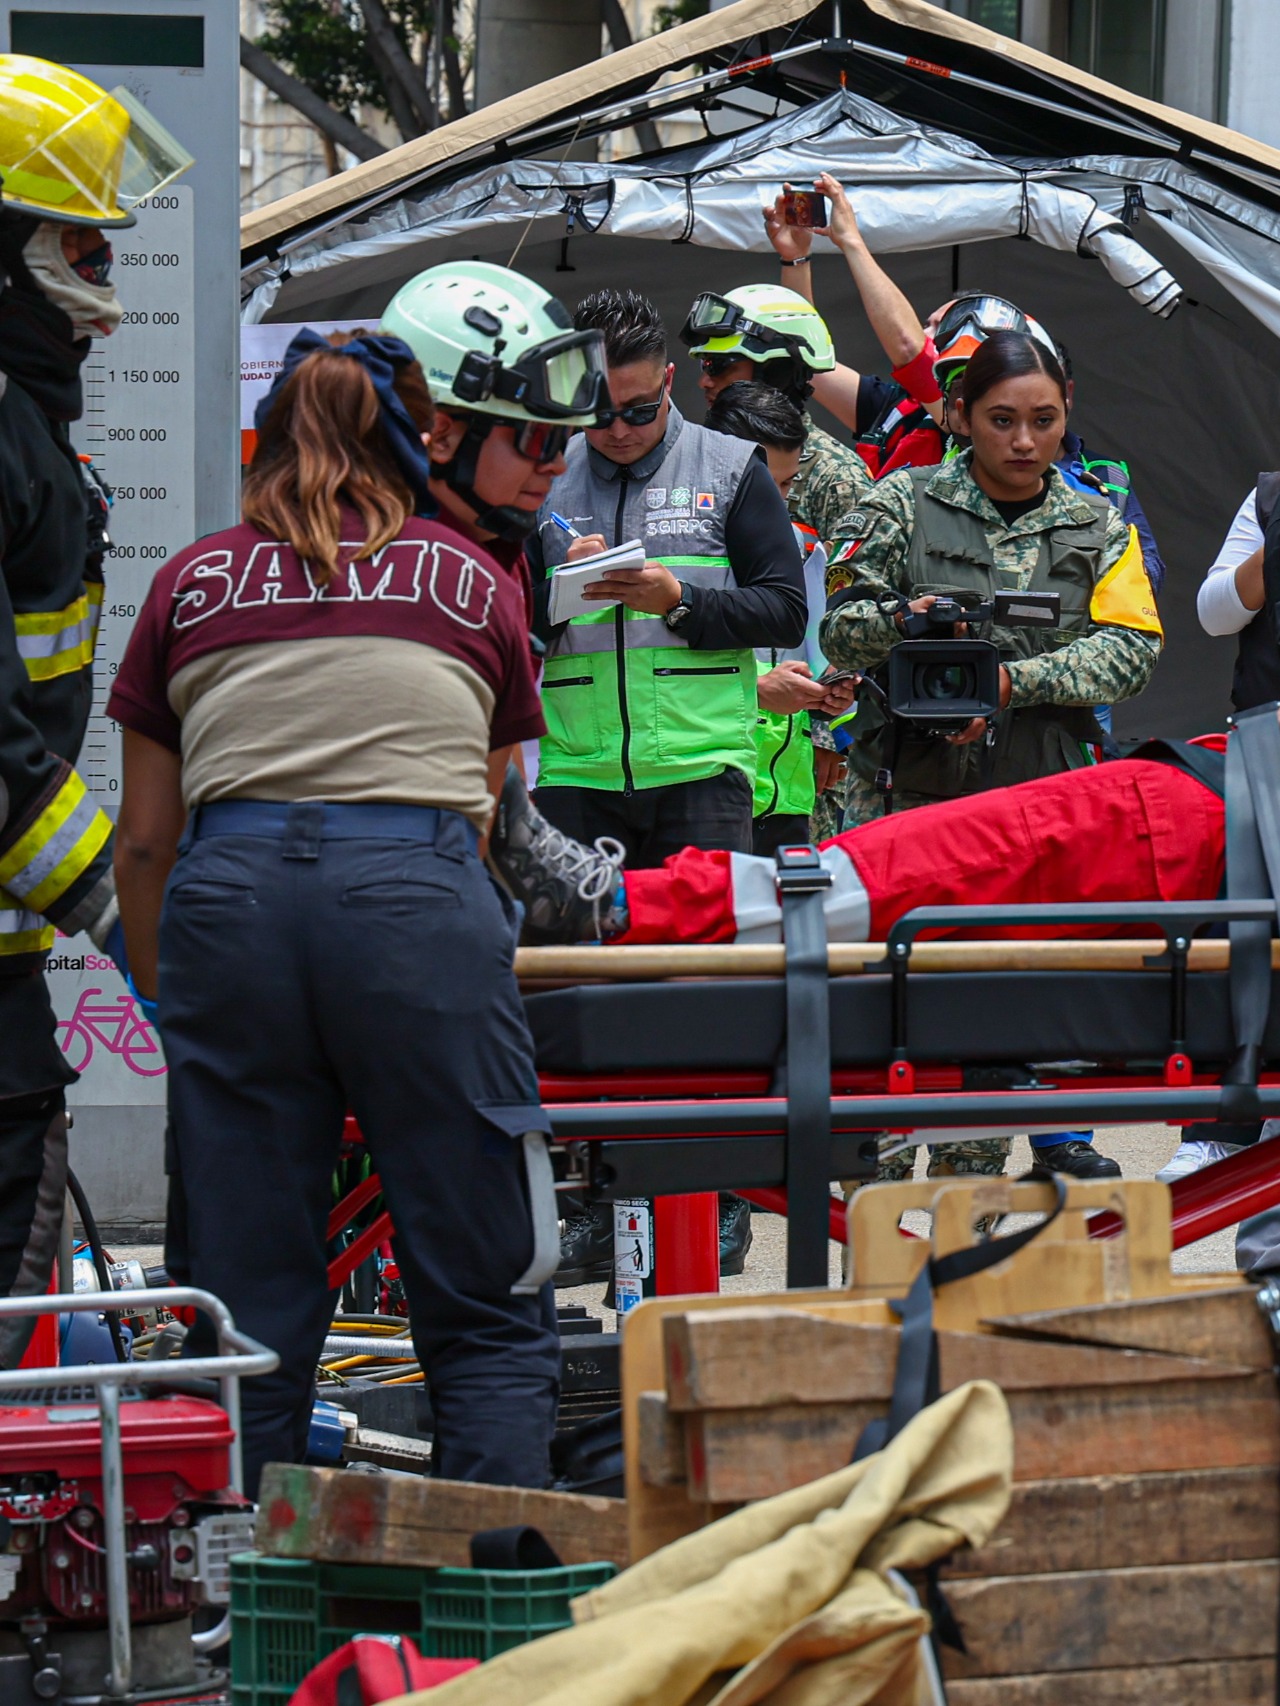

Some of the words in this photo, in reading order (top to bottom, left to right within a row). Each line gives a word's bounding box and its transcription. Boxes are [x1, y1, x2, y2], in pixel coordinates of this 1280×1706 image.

[152, 197, 178, 209] 000
[121, 254, 147, 266] 350
[152, 254, 179, 266] 000
[121, 312, 148, 324] 200
[152, 312, 179, 324] 000
[109, 371, 115, 382] 1
[123, 371, 148, 383] 150
[153, 371, 179, 383] 000
[108, 429, 135, 441] 900
[140, 429, 166, 441] 000
[110, 487, 135, 499] 750
[140, 487, 166, 499] 000
[646, 519, 714, 537] SGIRPC
[109, 546, 136, 558] 600
[140, 546, 167, 558] 000
[172, 539, 496, 629] SAMU
[109, 605, 136, 617] 450
[109, 662, 122, 675] 3
[109, 779, 118, 791] 0
